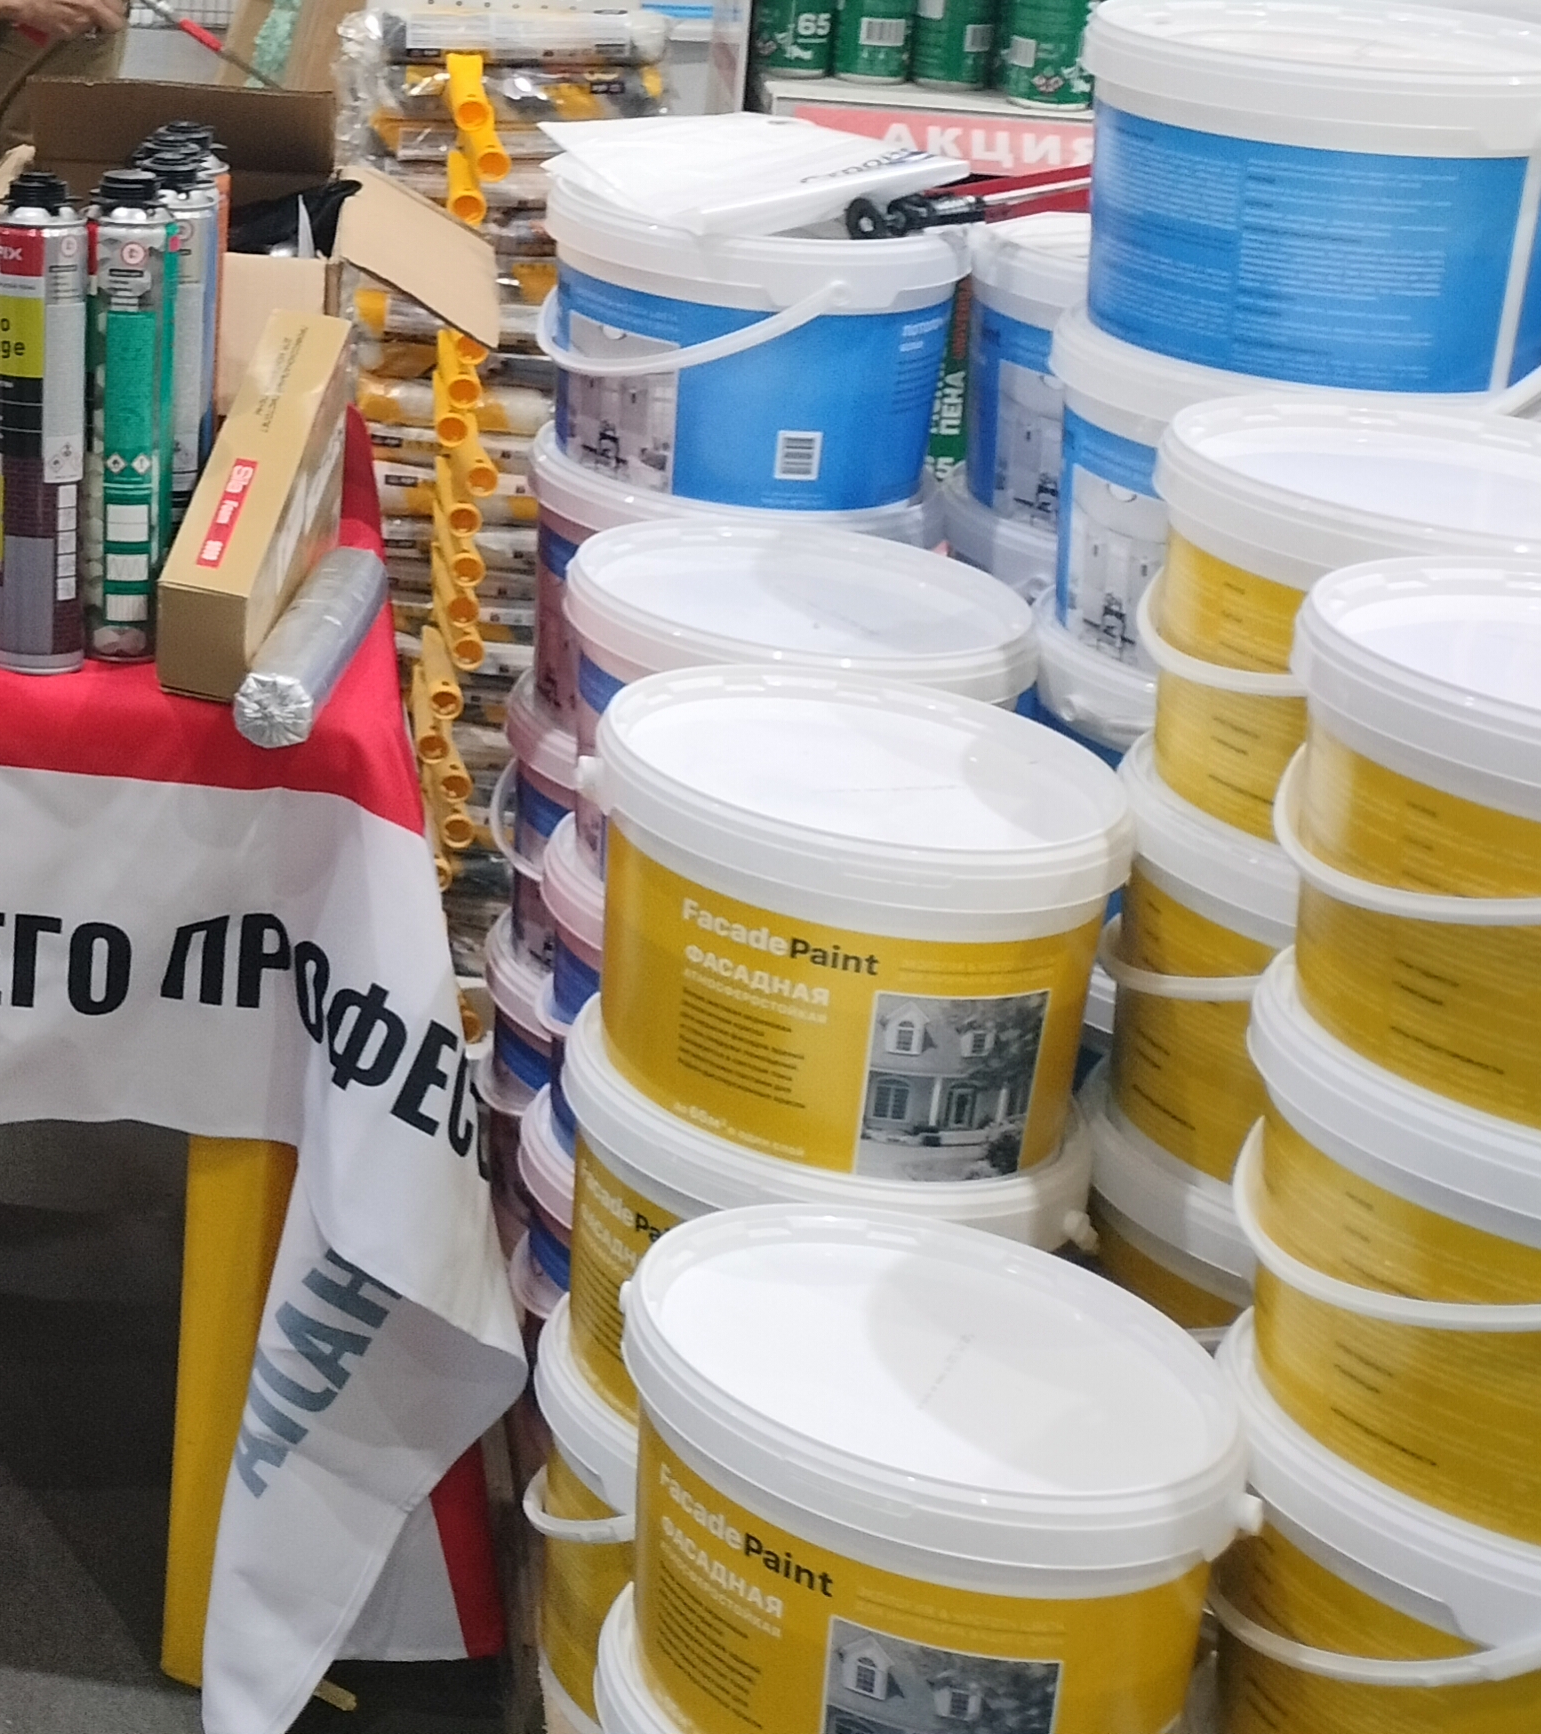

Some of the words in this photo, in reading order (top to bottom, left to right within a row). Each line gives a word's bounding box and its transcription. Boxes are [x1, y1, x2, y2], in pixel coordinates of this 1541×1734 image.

[797, 13, 831, 37] 65
[883, 123, 1094, 168] АКЦИЯ
[939, 370, 966, 434] ПЕНА
[225, 464, 254, 494] Sila
[685, 945, 829, 1006] ФАСАДНАЯ
[661, 1515, 784, 1619] ФАСАДНАЯ
